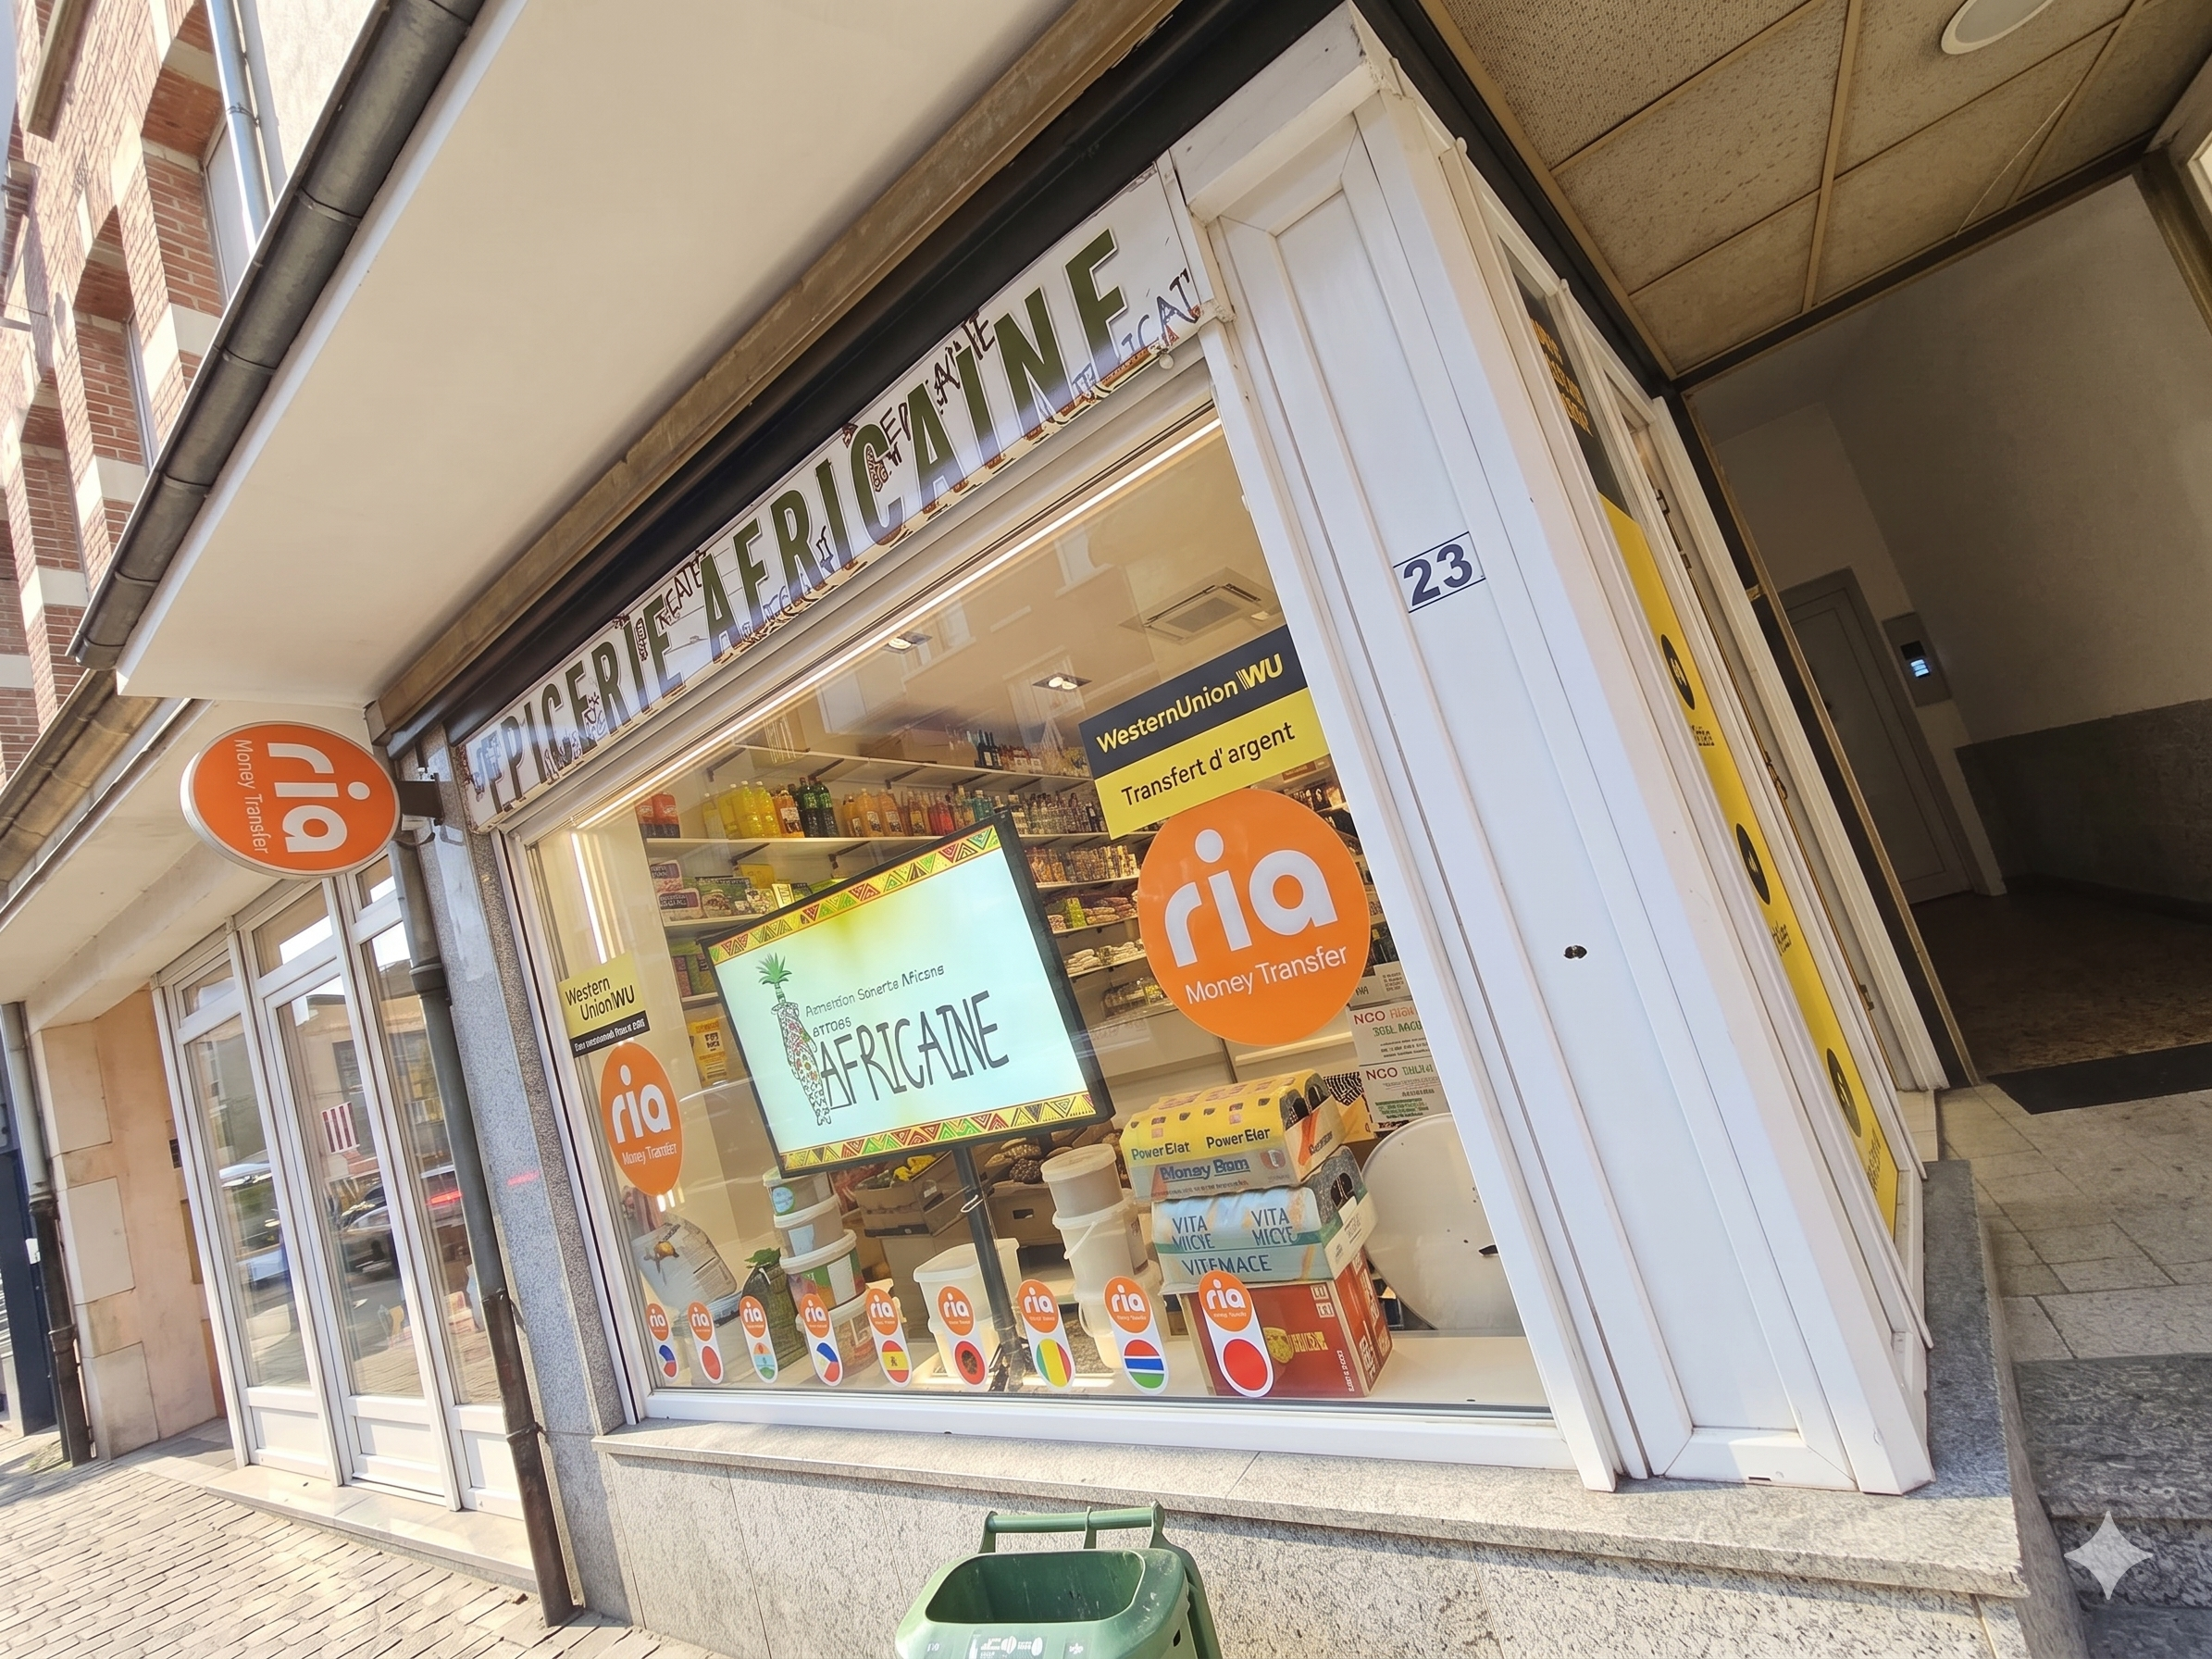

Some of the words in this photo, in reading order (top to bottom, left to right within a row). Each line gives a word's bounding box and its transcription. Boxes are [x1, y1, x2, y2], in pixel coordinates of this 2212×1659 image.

[1403, 543, 1473, 607] 23
[234, 739, 255, 790] Money
[1122, 759, 1207, 805] Transfert
[267, 742, 370, 853] ria
[244, 793, 268, 854] Transfer
[1163, 829, 1338, 968] ria
[1185, 971, 1253, 1004] Money
[1255, 945, 1348, 986] Transfer
[565, 977, 611, 1006] Western
[579, 996, 613, 1021] Union
[1353, 1010, 1386, 1025] NCO
[821, 990, 1010, 1110] AFRICAINE
[1366, 1066, 1398, 1081] NCO
[612, 1064, 671, 1144] ria
[1172, 1215, 1208, 1234] VITA
[1250, 1207, 1290, 1228] VITA
[870, 1294, 895, 1318] ria
[942, 1292, 970, 1317] ria
[1024, 1287, 1054, 1314] ria
[1111, 1284, 1146, 1313] ria
[1206, 1279, 1246, 1310] ria
[650, 1308, 666, 1328] ria
[693, 1307, 710, 1327] ria
[743, 1301, 764, 1323] ria
[804, 1300, 826, 1322] ria
